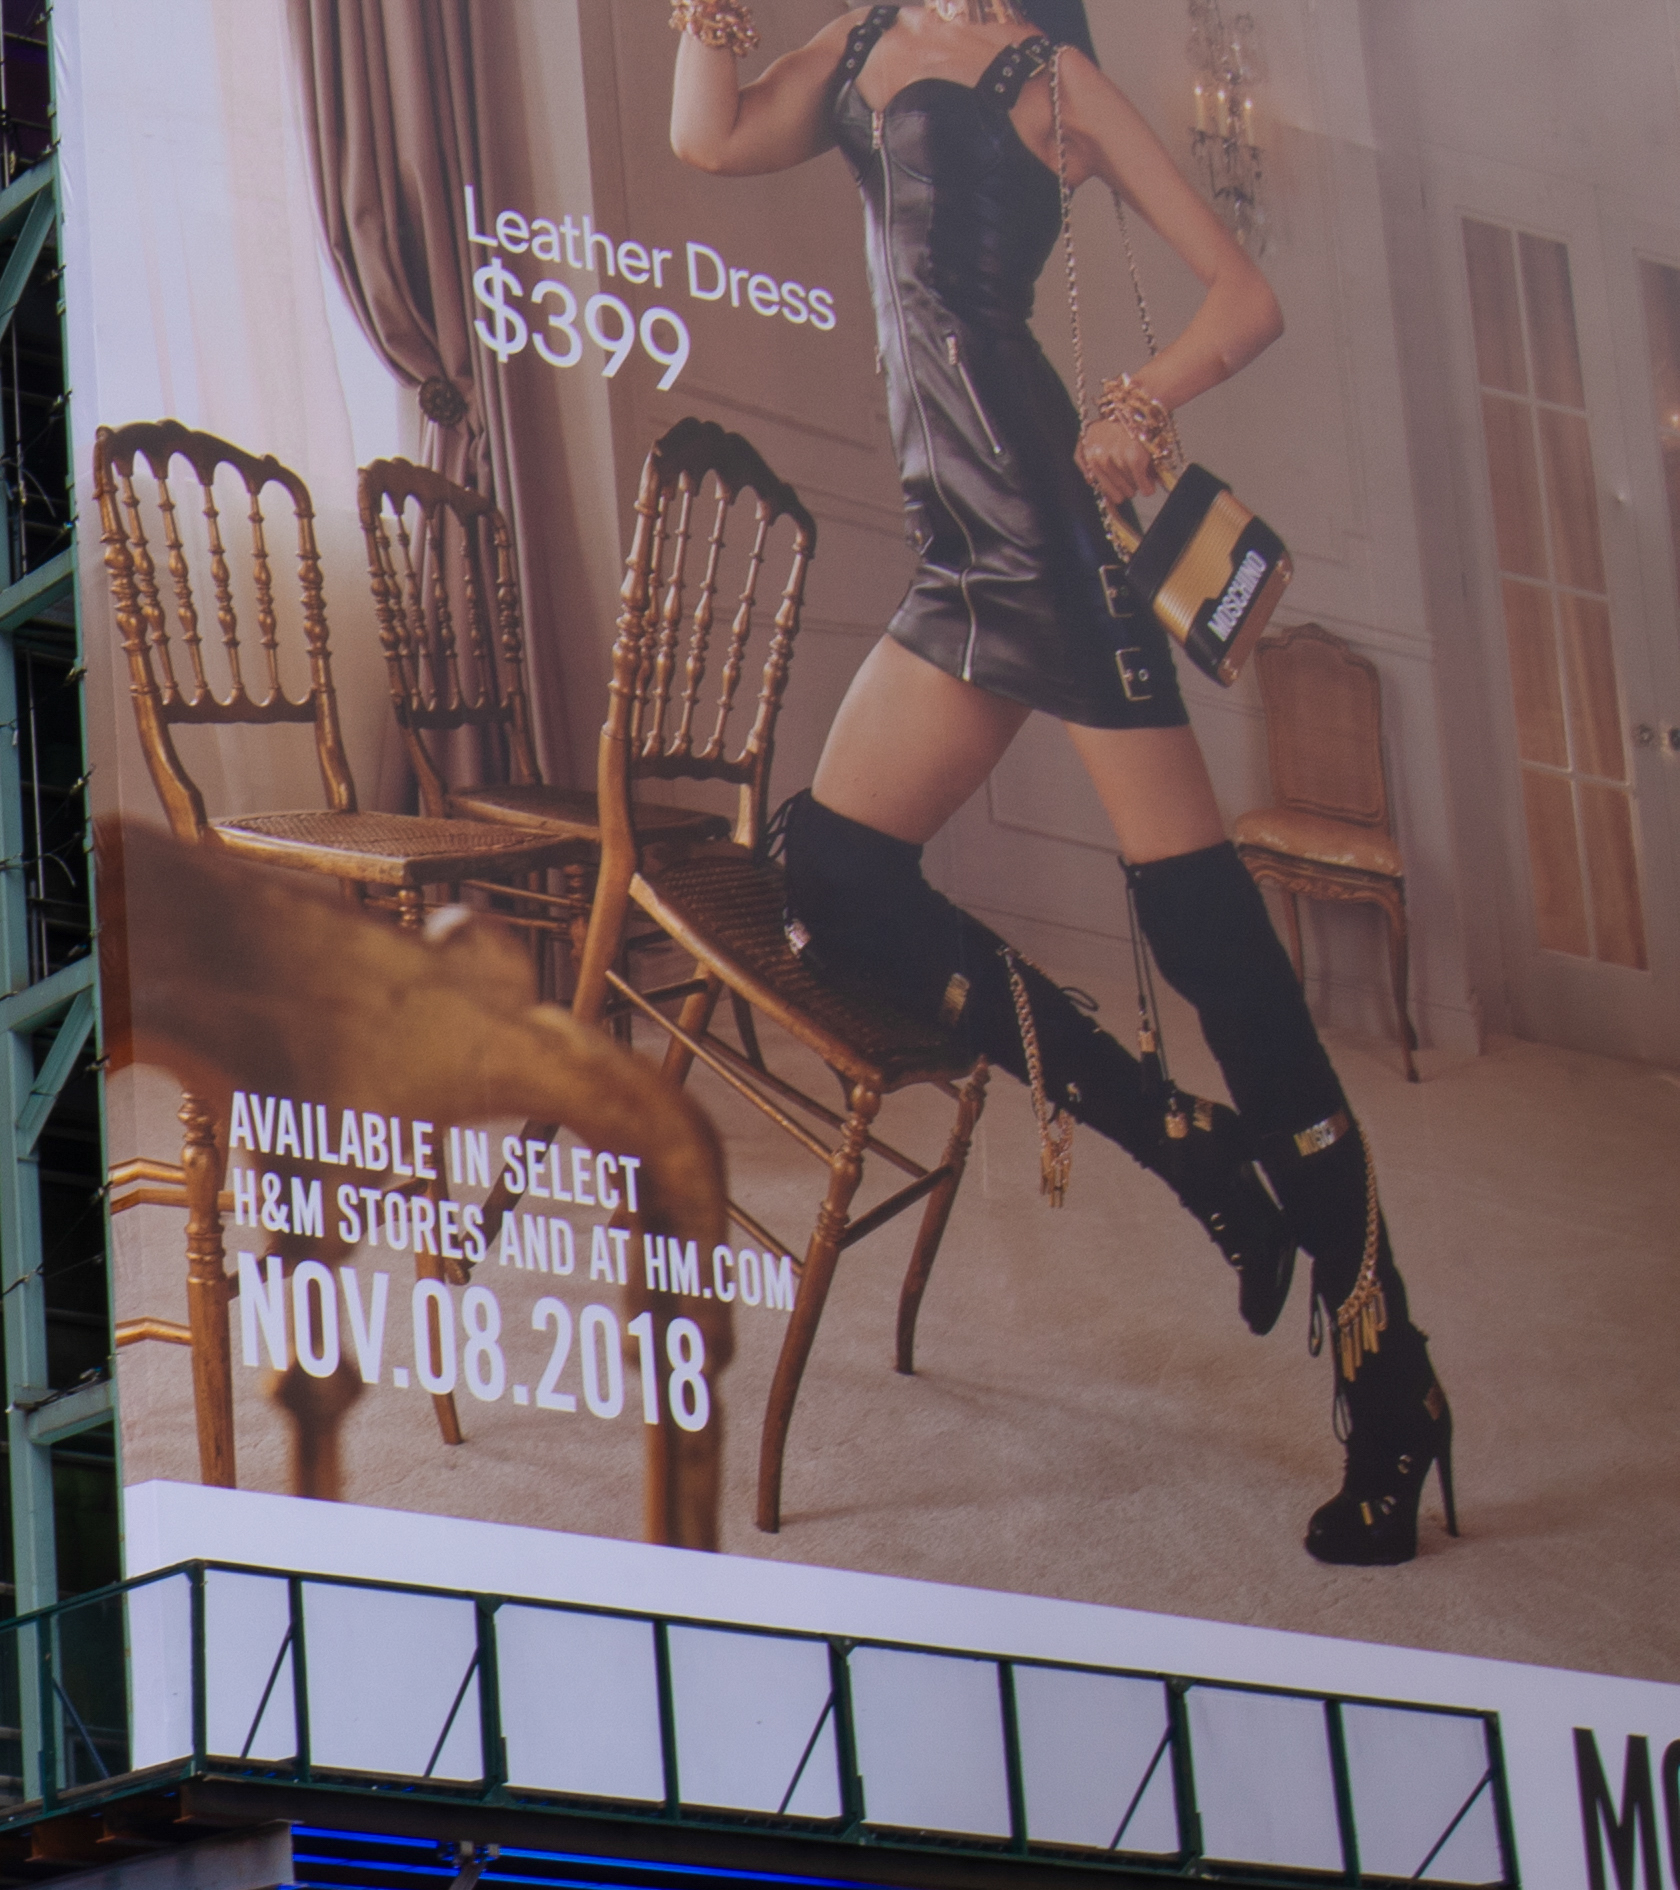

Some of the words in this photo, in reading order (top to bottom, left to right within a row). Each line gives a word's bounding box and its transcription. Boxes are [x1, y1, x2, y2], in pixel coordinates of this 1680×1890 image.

[463, 184, 673, 288] Leather
[686, 241, 837, 331] Dress
[472, 257, 691, 391] $399
[1206, 548, 1270, 642] MOSCHINO
[229, 1090, 436, 1180] AVAILABLE
[449, 1127, 490, 1188] IN
[502, 1137, 641, 1213] SELECT
[231, 1169, 325, 1239] H&M
[336, 1185, 487, 1264] STORES
[498, 1213, 577, 1276] AND
[589, 1225, 630, 1286] AT
[643, 1234, 796, 1312] HM.COM
[236, 1252, 710, 1432] NOV.08.2018
